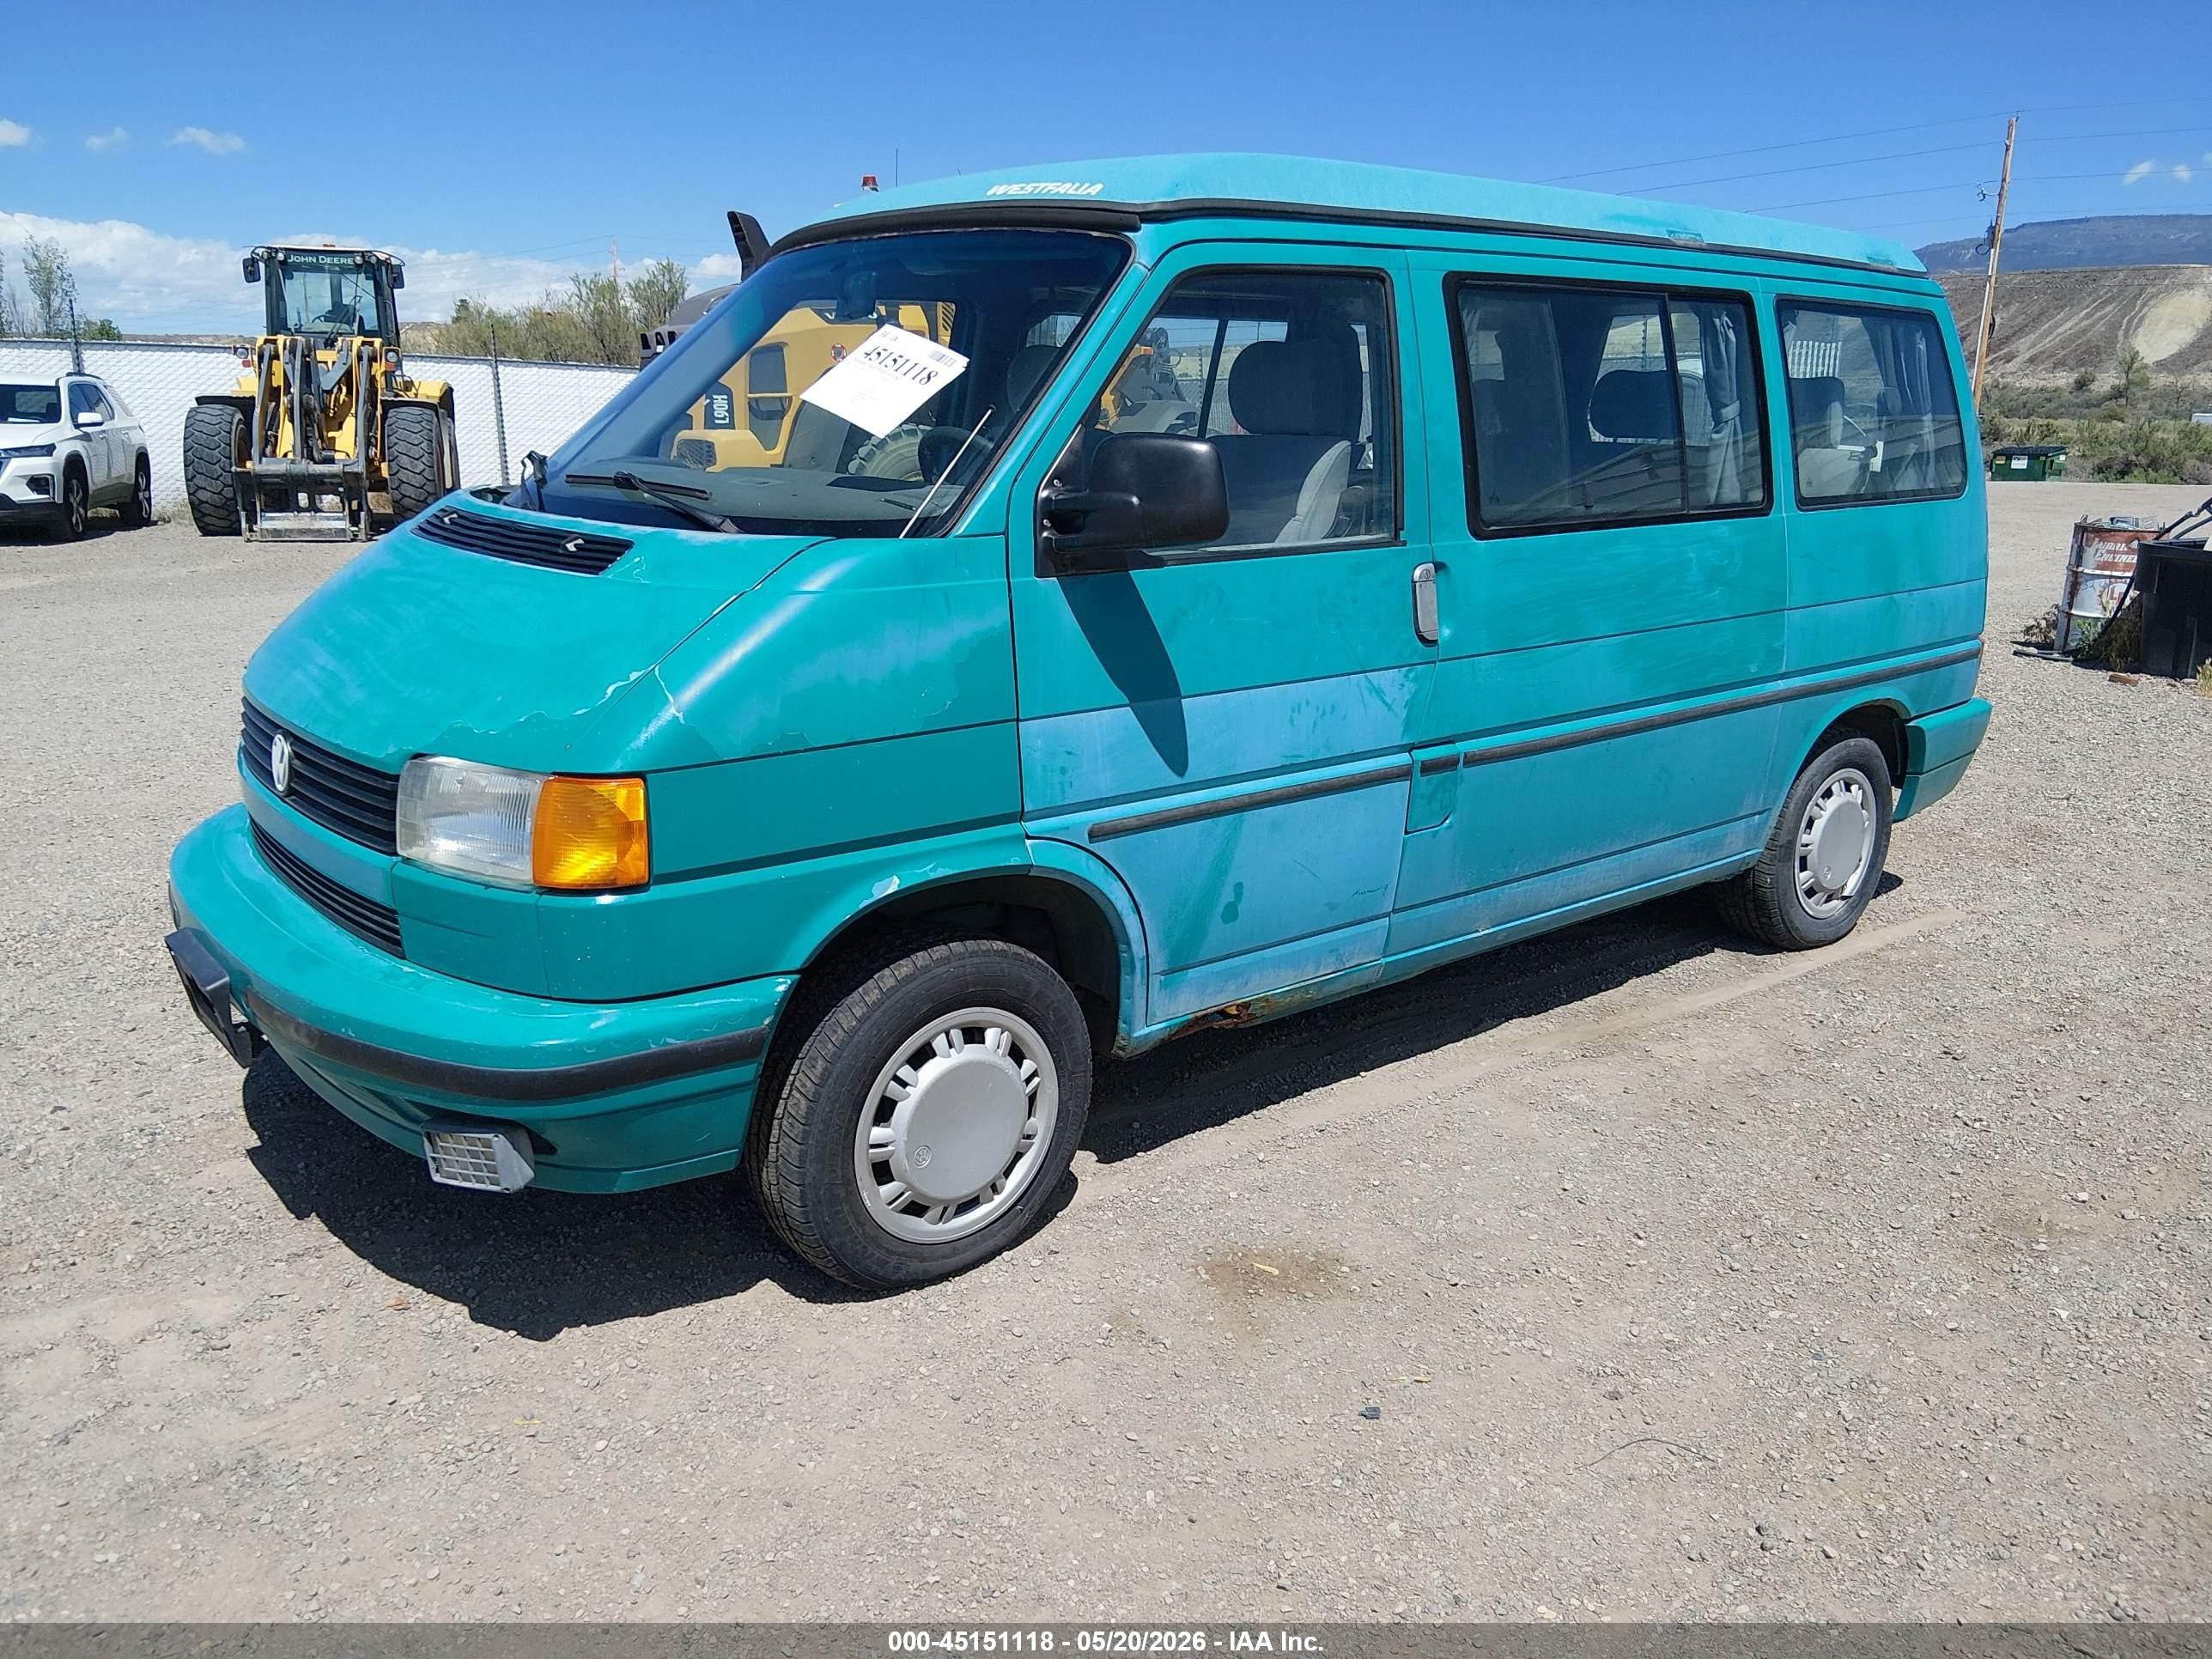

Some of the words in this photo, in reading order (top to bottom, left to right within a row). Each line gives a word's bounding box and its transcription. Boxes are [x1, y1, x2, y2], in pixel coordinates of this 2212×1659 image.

[987, 182, 1103, 196] WESTFALIA
[287, 254, 317, 264] JOHN
[318, 255, 355, 264] DEERE
[863, 345, 939, 386] 45151118
[712, 394, 729, 424] L90H
